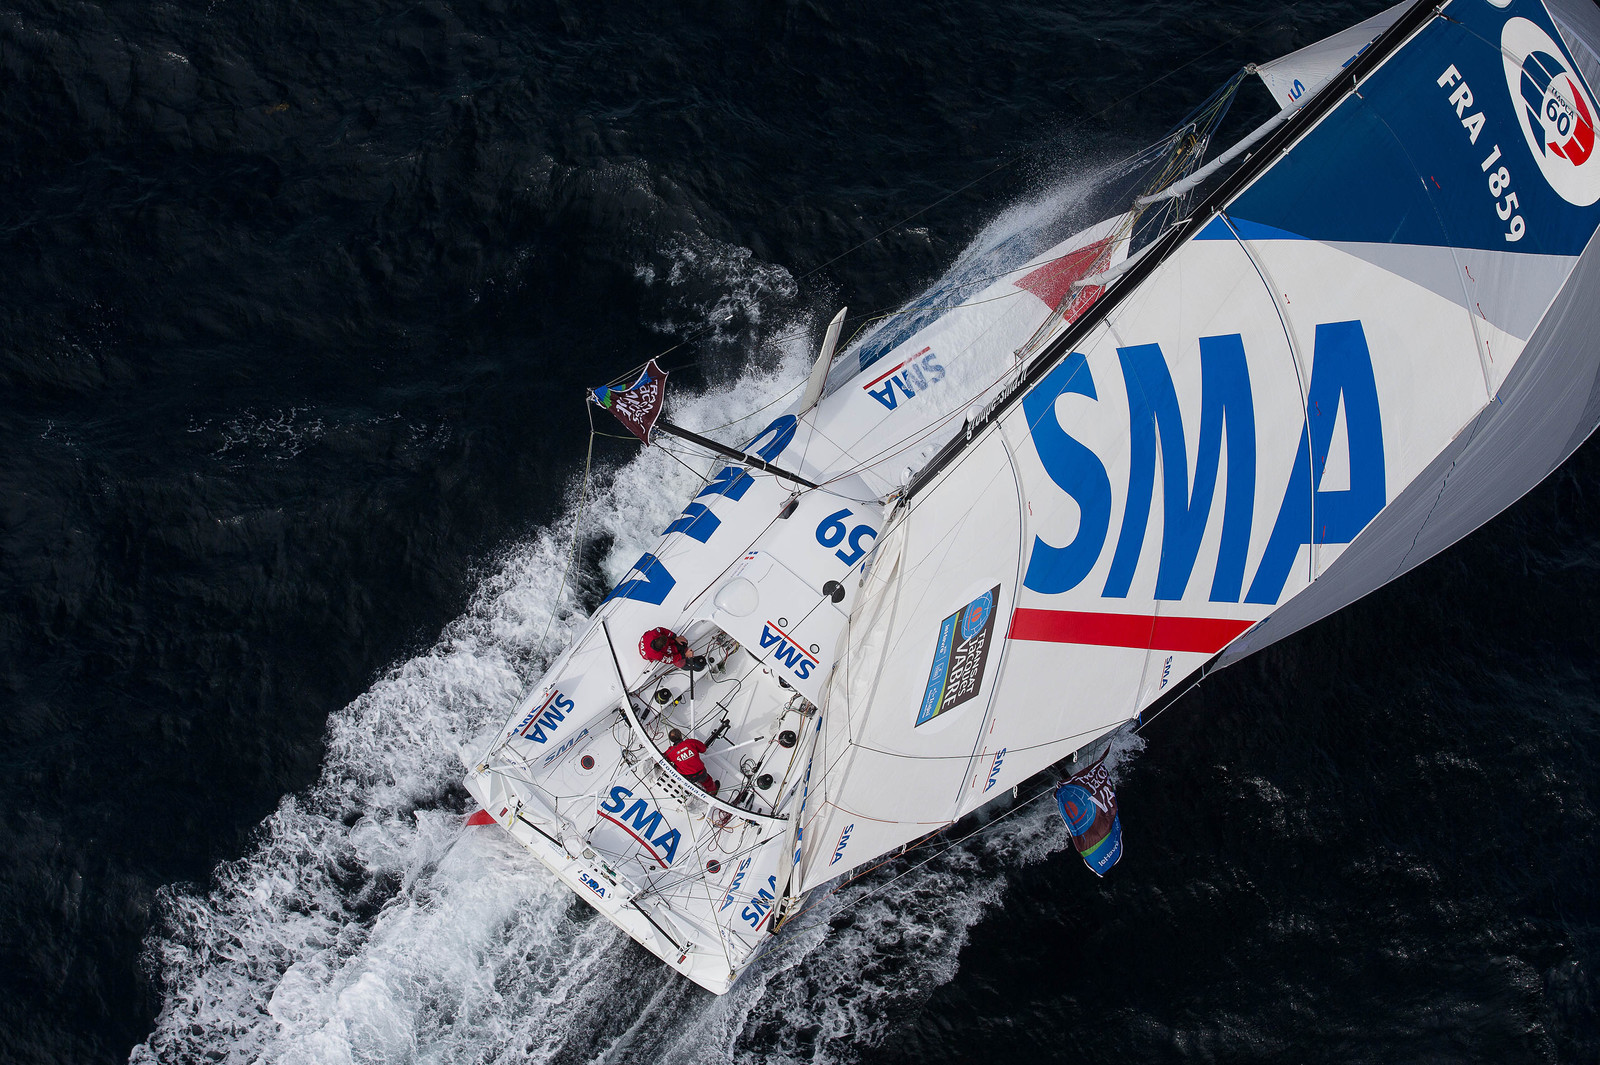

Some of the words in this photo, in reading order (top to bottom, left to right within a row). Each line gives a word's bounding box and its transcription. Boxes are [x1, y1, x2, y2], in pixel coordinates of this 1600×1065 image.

[1546, 98, 1571, 136] 60
[1436, 64, 1486, 145] FRA
[1480, 145, 1526, 242] 1859
[867, 353, 946, 411] SMA
[1022, 320, 1386, 605] SMA
[815, 508, 878, 567] 59
[759, 625, 816, 680] SMA
[941, 634, 972, 710] VABRE
[966, 628, 987, 693] TRANSAT
[1160, 655, 1174, 689] SMA
[524, 693, 575, 744] SMA
[676, 749, 694, 762] SMA
[985, 747, 1007, 793] SMA
[600, 785, 683, 865] SMA
[832, 823, 855, 865] SMA
[579, 873, 606, 898] SMA
[721, 857, 752, 911] SMA
